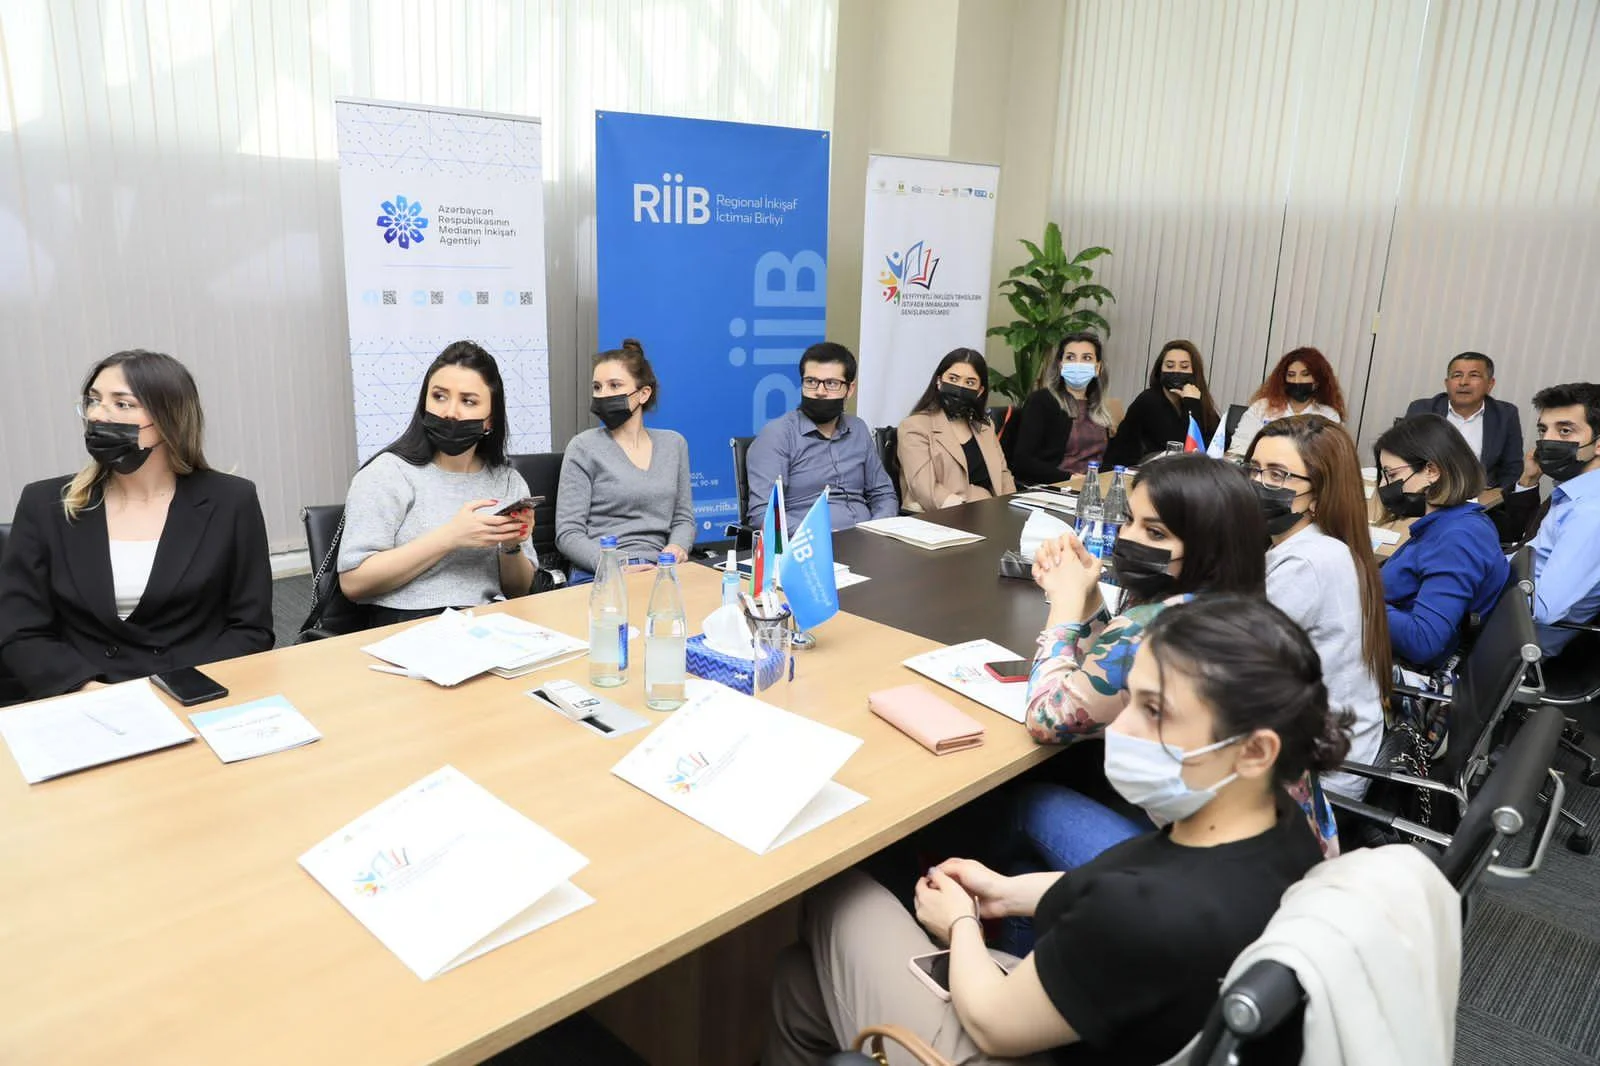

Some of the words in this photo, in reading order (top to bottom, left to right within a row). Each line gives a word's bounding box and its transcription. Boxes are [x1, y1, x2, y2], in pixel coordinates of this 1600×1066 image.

[716, 194, 763, 209] Regional
[765, 193, 799, 212] İnkişaf
[438, 205, 494, 216] Azərbaycan
[438, 215, 510, 227] Respublikasının
[716, 207, 753, 224] İctimai
[754, 212, 784, 227] Birliyi
[439, 226, 482, 236] Medianın
[439, 236, 481, 247] Agentliyi
